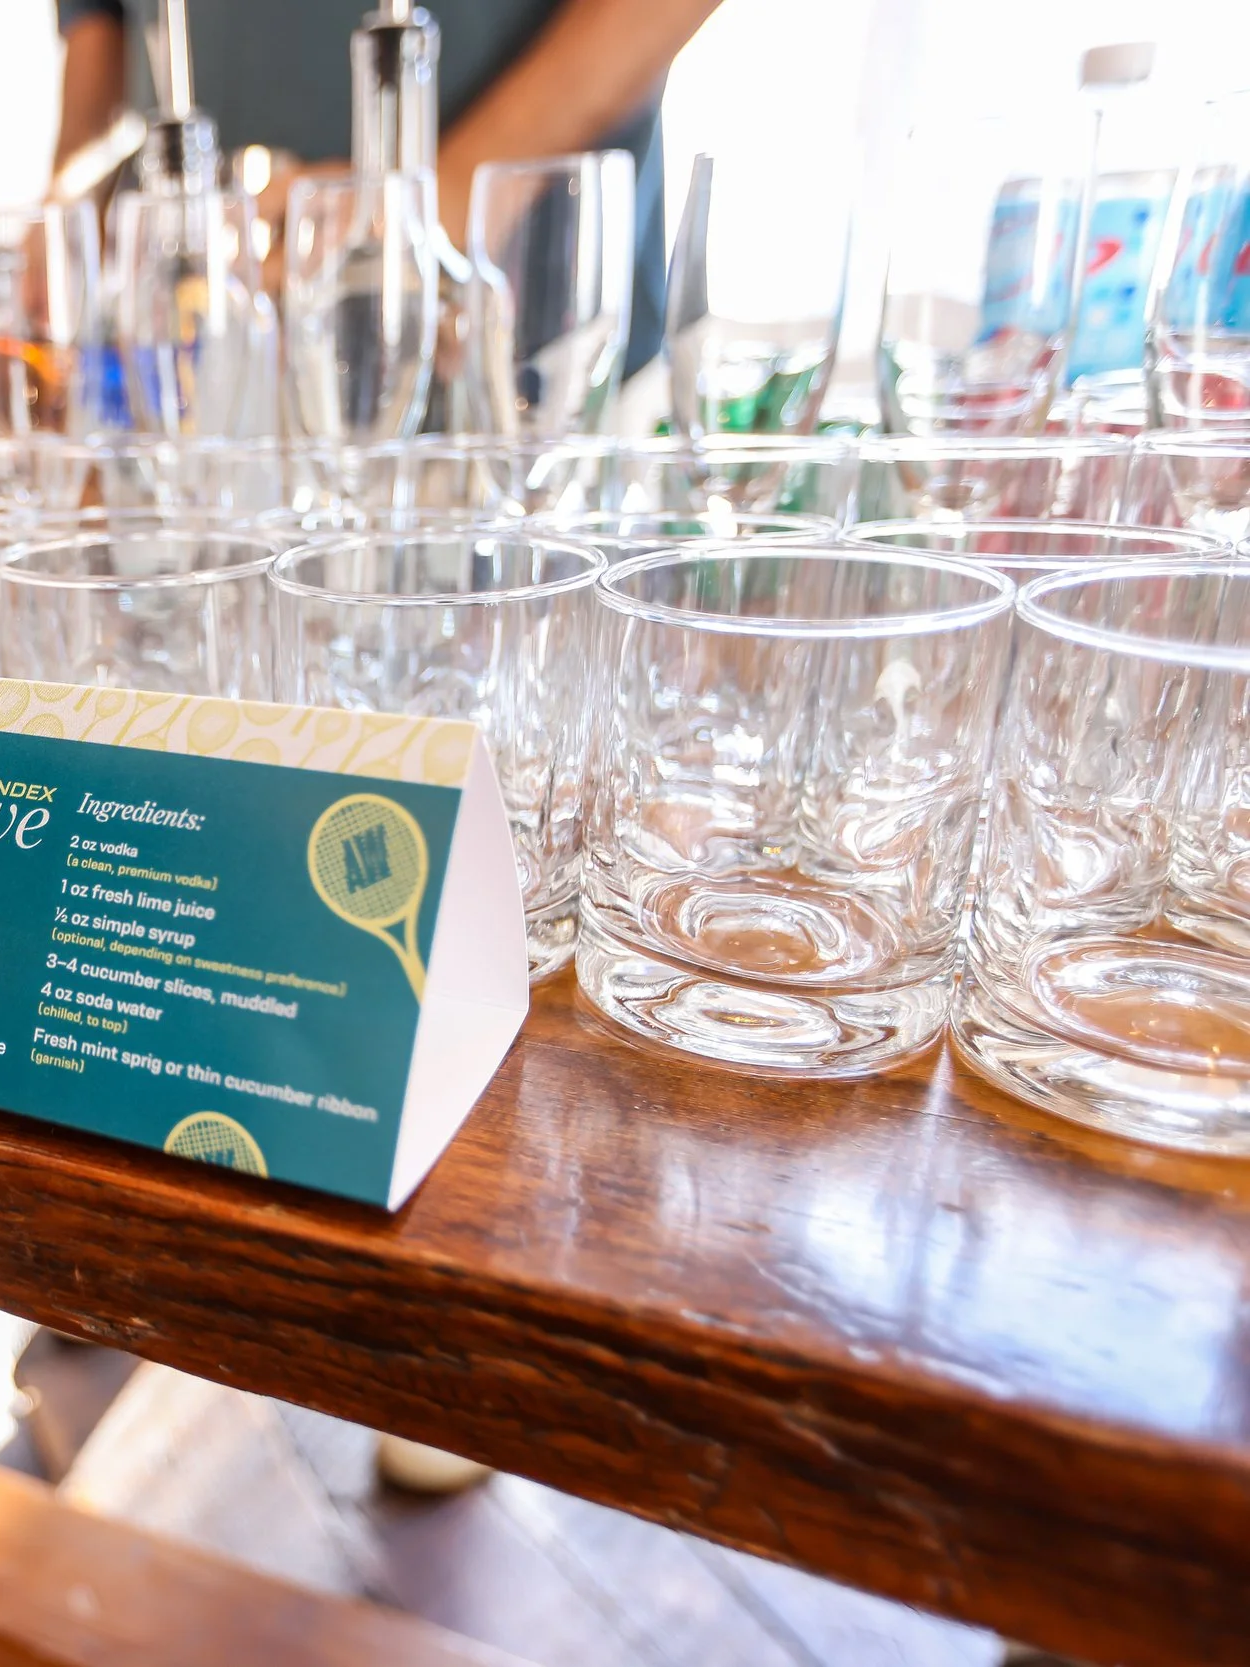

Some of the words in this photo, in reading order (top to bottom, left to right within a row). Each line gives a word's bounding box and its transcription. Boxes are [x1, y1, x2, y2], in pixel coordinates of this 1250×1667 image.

[77, 792, 206, 831] Ingredients:
[70, 835, 80, 848] 2
[81, 840, 97, 851] oz
[100, 842, 139, 858] vodka
[66, 853, 79, 867] (a
[81, 858, 115, 875] clean,
[117, 865, 172, 883] premium
[174, 873, 219, 892] vodka)
[61, 879, 68, 894] 1
[70, 884, 88, 898] oz
[91, 885, 134, 905] fresh
[136, 892, 172, 912] lime
[173, 898, 216, 921] juice
[71, 913, 89, 927] oz
[92, 915, 146, 937] simple
[148, 926, 196, 949] syrup
[51, 927, 106, 952] (optional,
[109, 940, 173, 965] depending
[175, 954, 192, 966] on
[194, 957, 264, 981] sweetness
[264, 970, 349, 998] preference)
[40, 981, 53, 997] 4
[55, 987, 73, 1001] oz
[76, 992, 114, 1011] soda
[116, 999, 164, 1022] water
[80, 962, 162, 990] cucumber
[163, 977, 216, 1006] slices,
[220, 991, 299, 1020] muddled
[37, 1001, 84, 1026] (chilled,
[86, 1014, 100, 1027] to
[101, 1017, 129, 1034] top)
[30, 1048, 86, 1074] (garnish)
[33, 1027, 78, 1051] Fresh
[80, 1041, 119, 1062] mint
[120, 1051, 163, 1076] sprig
[164, 1061, 184, 1077] or
[186, 1063, 222, 1085] thin
[223, 1074, 316, 1107] cucumber
[316, 1094, 380, 1123] ribbon
